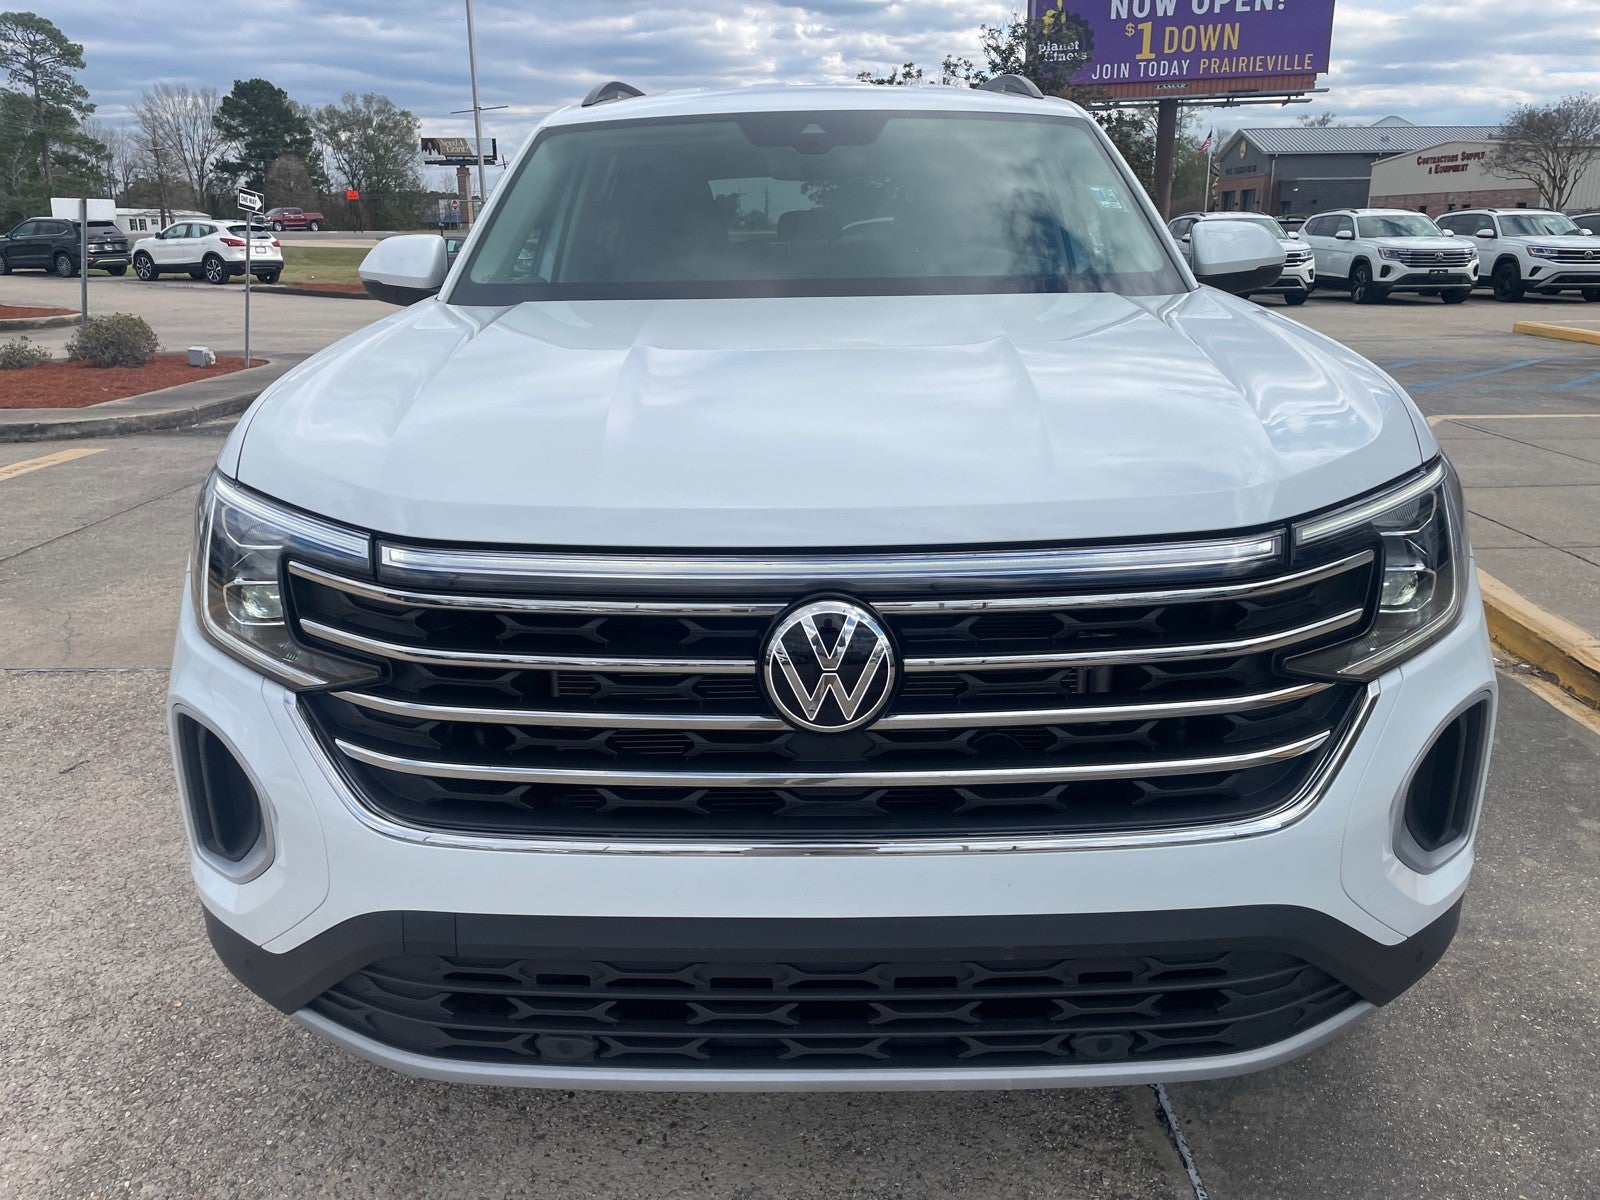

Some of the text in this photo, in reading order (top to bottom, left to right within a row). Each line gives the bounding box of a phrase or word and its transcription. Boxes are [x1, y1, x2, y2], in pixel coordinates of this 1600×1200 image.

[1110, 0, 1177, 20] NOW
[1164, 23, 1240, 54] DOWN
[1092, 53, 1313, 80] JOIN TODAY PRAIRIEVILLE
[1461, 151, 1486, 161] SUPPLY
